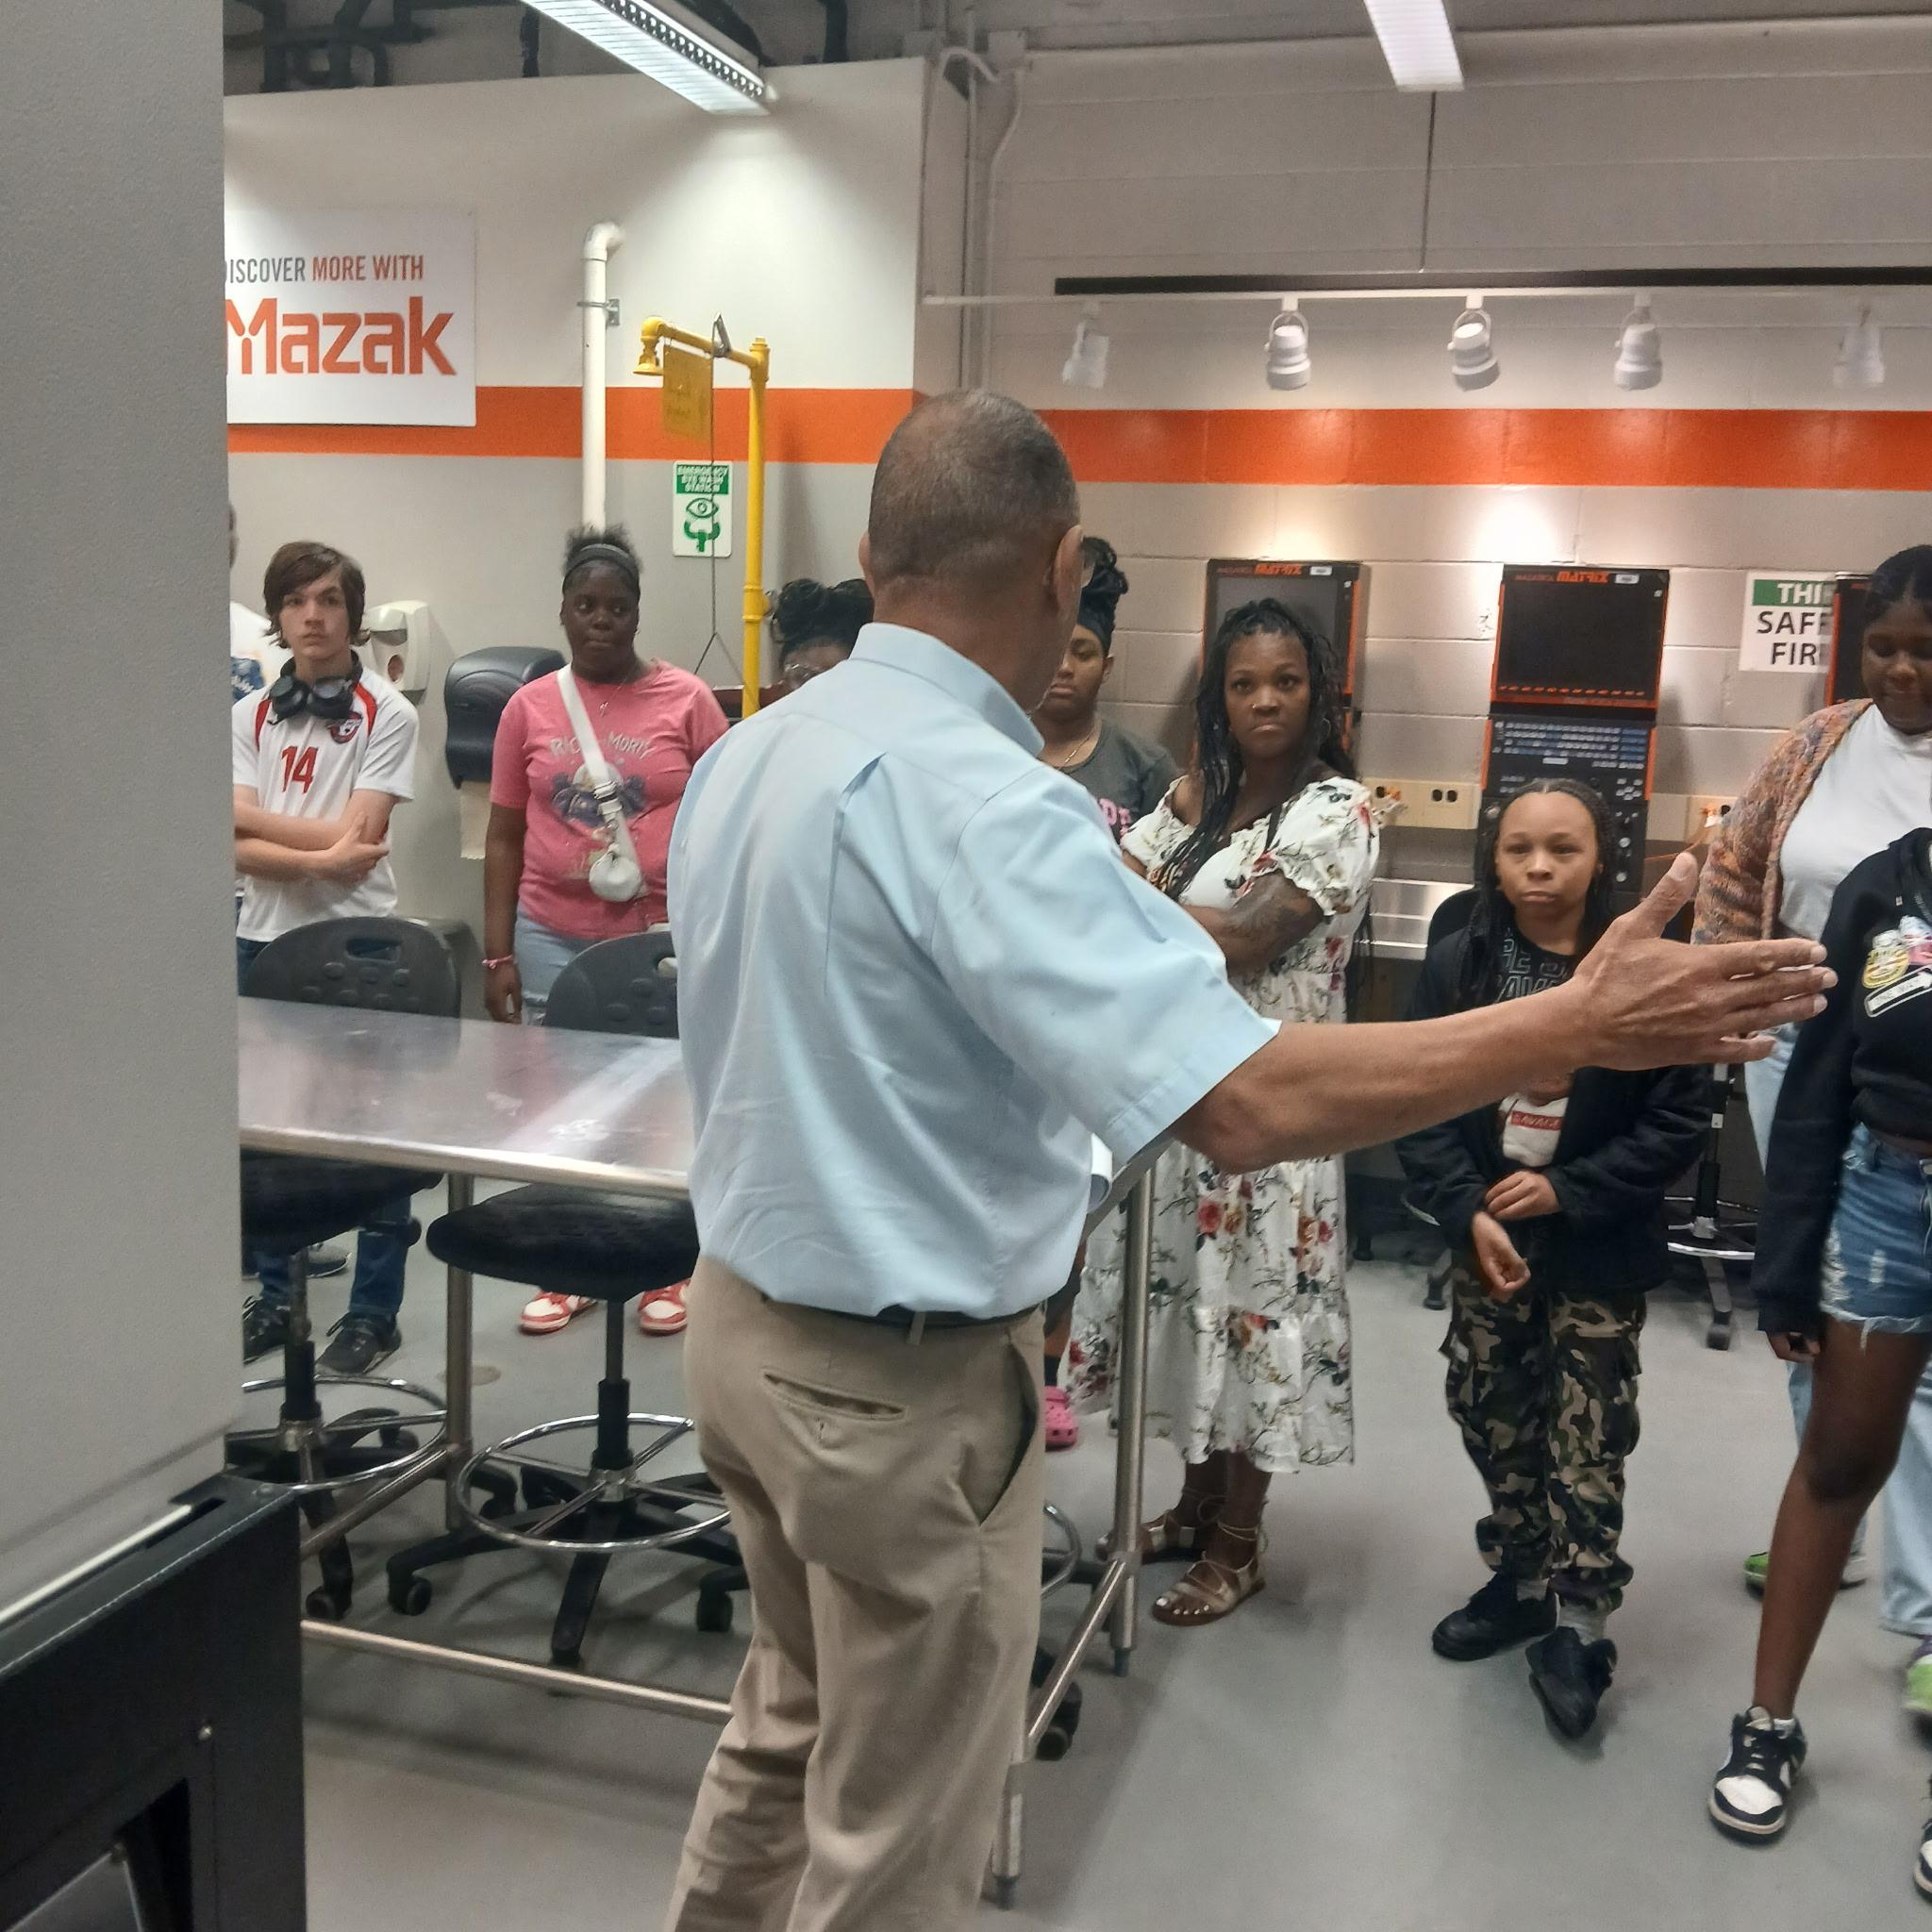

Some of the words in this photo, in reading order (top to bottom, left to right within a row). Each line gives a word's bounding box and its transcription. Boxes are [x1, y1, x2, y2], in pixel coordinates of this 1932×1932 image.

[225, 258, 306, 283] ISCOVER
[312, 256, 366, 281] MORE
[373, 255, 424, 281] WITH
[225, 296, 457, 375] Mazak
[1776, 582, 1828, 604] THI
[1770, 642, 1822, 665] FIR
[281, 746, 319, 794] 14
